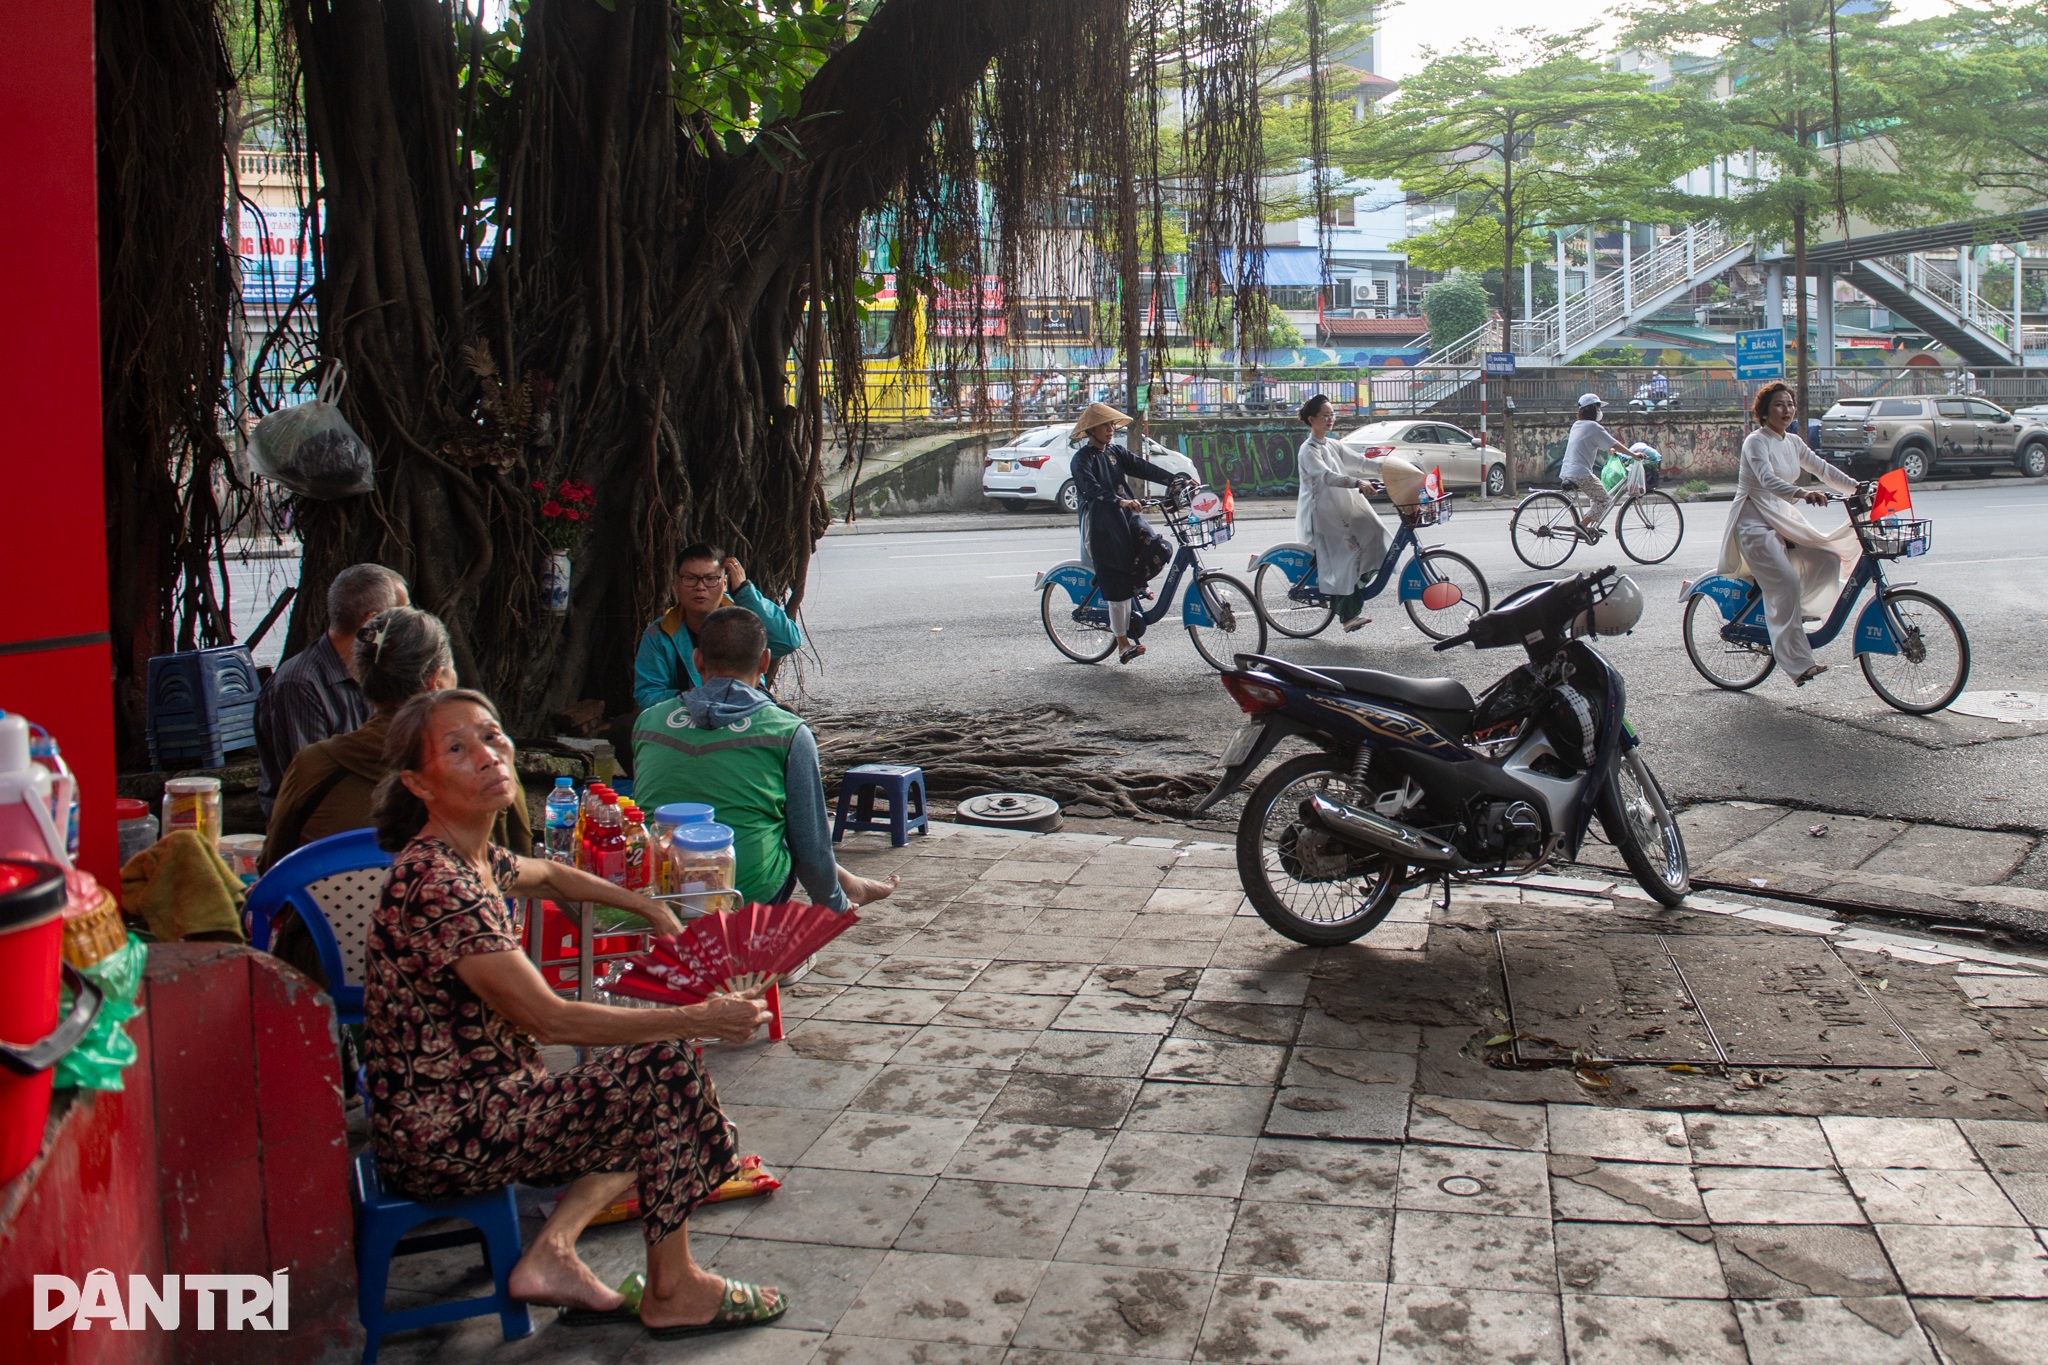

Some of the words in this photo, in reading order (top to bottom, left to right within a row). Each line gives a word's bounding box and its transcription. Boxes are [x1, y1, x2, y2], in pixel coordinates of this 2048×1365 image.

[1752, 337, 1766, 350] BẮC
[1767, 338, 1777, 348] HÀ
[1866, 626, 1882, 637] TN
[626, 845, 644, 867] C2
